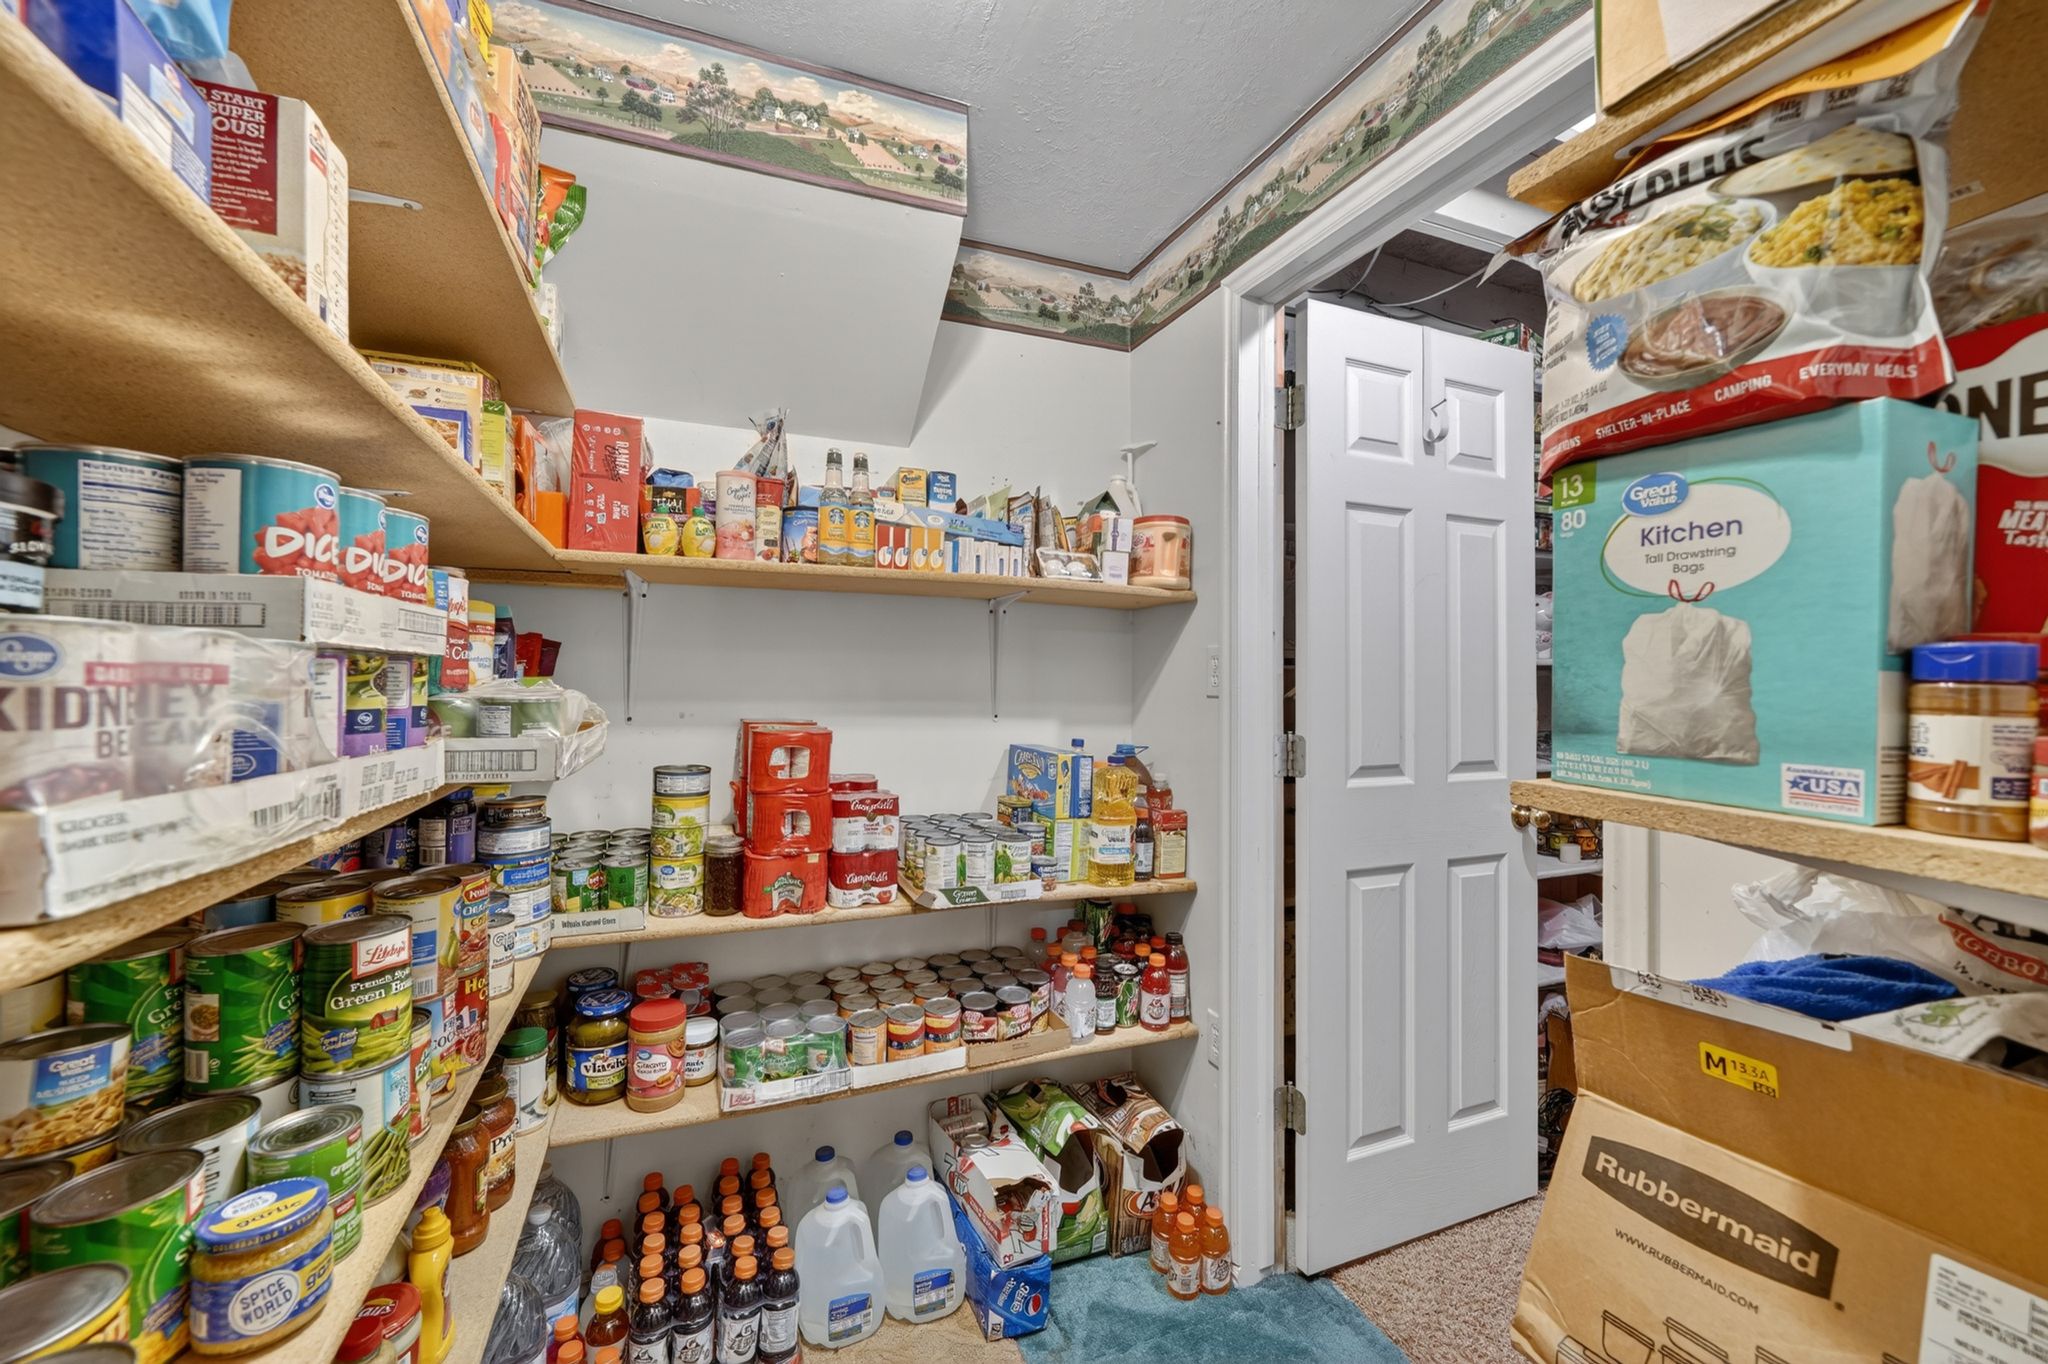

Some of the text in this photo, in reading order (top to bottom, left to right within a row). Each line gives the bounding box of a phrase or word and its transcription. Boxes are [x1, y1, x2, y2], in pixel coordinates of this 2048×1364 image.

[210, 89, 267, 110] START
[207, 101, 267, 124] SUPER
[1798, 362, 1919, 380] EVERYDAY MEALS
[1595, 399, 1692, 440] SHELTER-IN-PLACE
[1713, 374, 1773, 402] CAMPING
[1560, 474, 1584, 499] 13
[1630, 480, 1679, 501] Great
[1640, 494, 1678, 508] Value
[1560, 508, 1587, 531] 80
[1997, 509, 2048, 531] MEA
[1639, 517, 1744, 547] Kitchen
[1644, 545, 1737, 565] Tall Drawstring
[1672, 562, 1705, 575] Bags
[1808, 778, 1860, 797] USA
[350, 974, 393, 993] French
[330, 988, 386, 1011] Green
[1704, 1050, 1727, 1076] M
[1594, 1150, 1821, 1279] Rubbermaid
[239, 1276, 287, 1311] SPICE
[240, 1288, 293, 1326] WORLD
